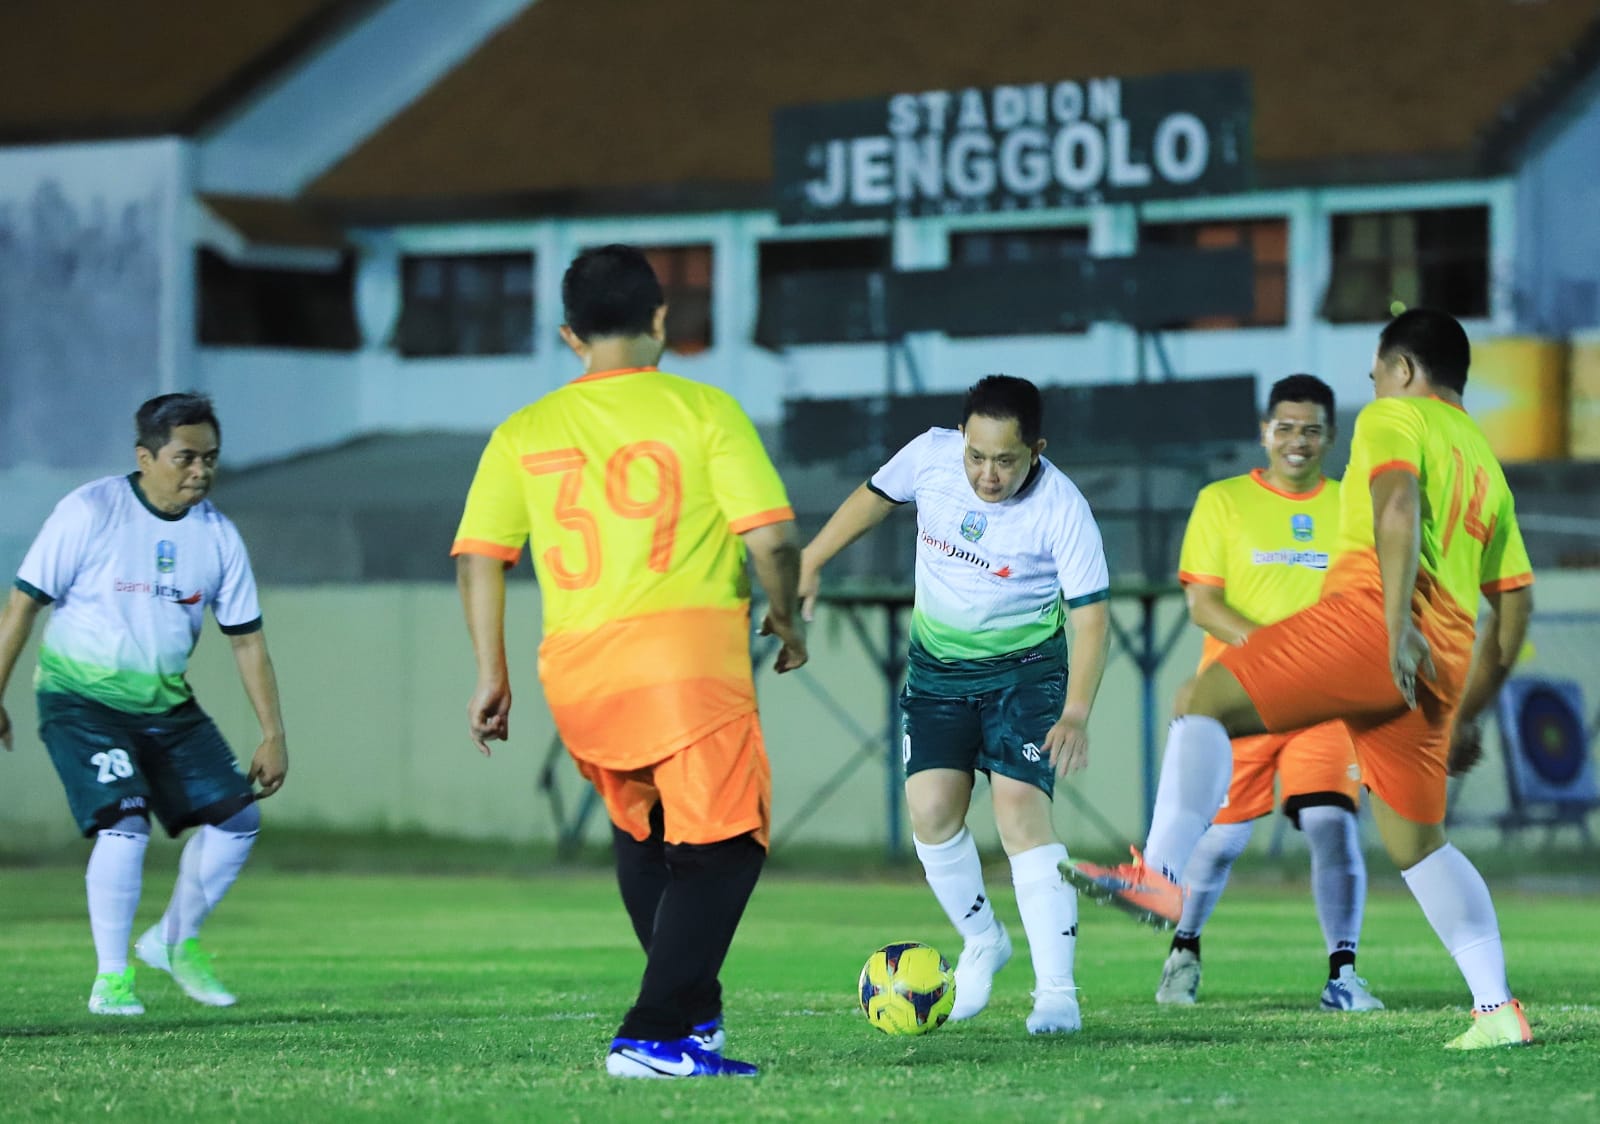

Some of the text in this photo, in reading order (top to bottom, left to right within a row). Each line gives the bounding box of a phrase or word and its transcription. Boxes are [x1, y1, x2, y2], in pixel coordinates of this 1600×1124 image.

[888, 77, 1122, 136] STADION
[804, 112, 1210, 207] JENGGOLO
[520, 440, 684, 591] 39
[90, 747, 134, 785] 28
